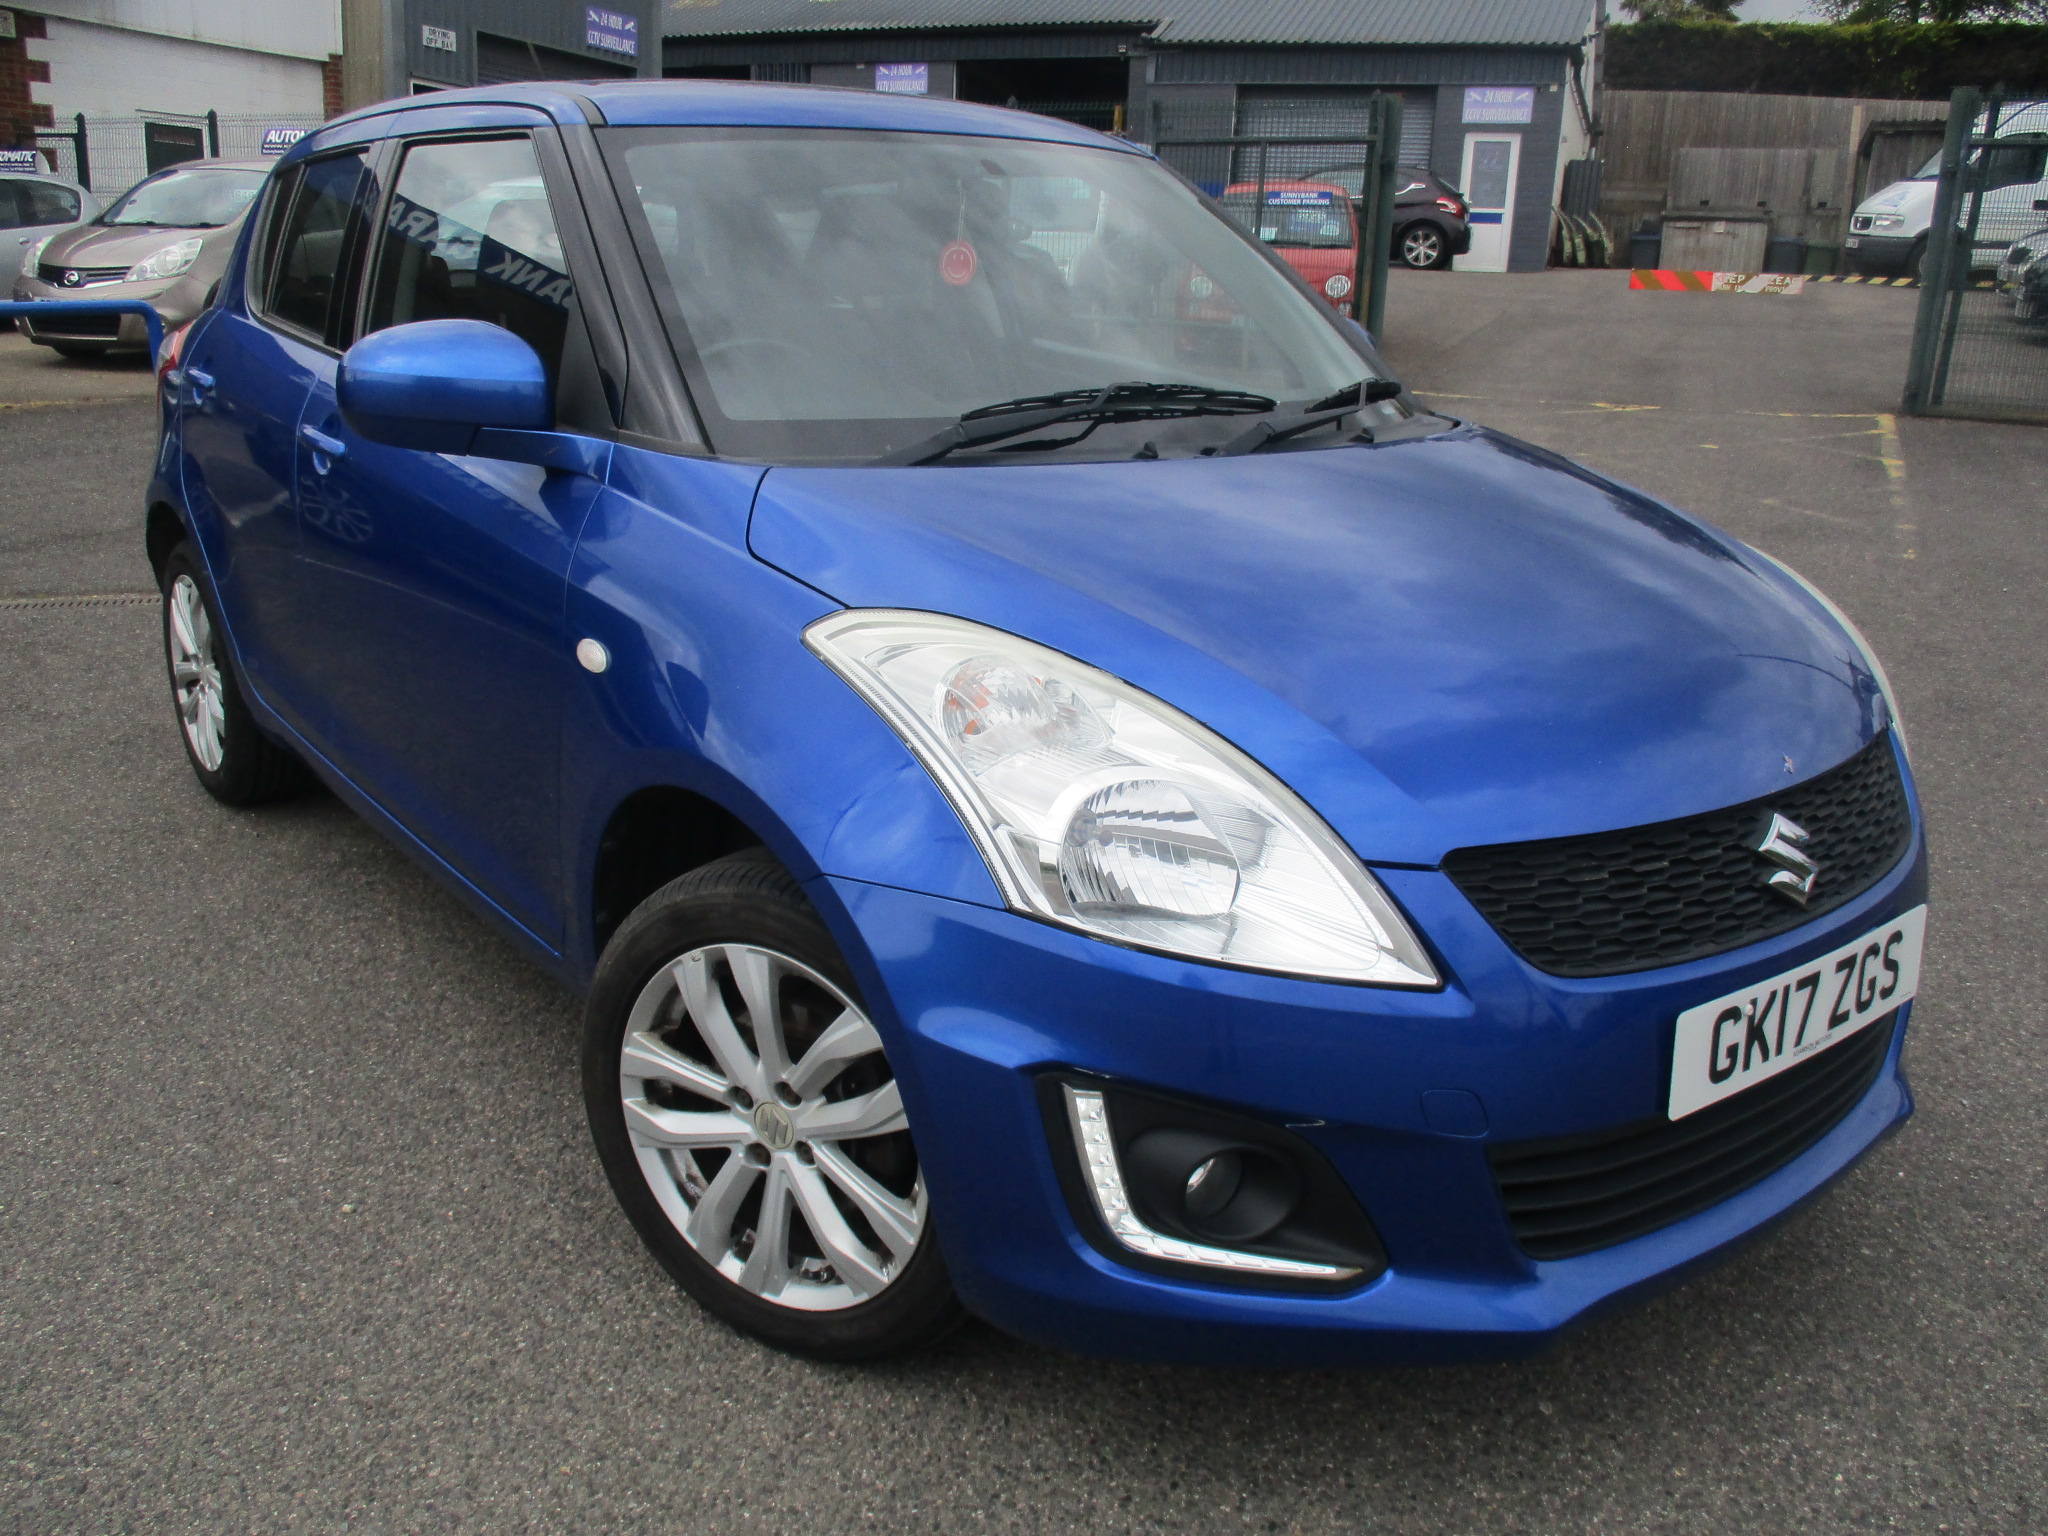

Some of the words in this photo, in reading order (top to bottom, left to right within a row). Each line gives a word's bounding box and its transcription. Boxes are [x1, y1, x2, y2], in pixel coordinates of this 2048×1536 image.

[608, 14, 623, 30] HOUR
[600, 33, 635, 54] SURVEILLANCE
[1481, 108, 1528, 121] SURVEILLANCE
[1708, 970, 1821, 1084] GK17
[1827, 930, 1903, 1031] ZGS
